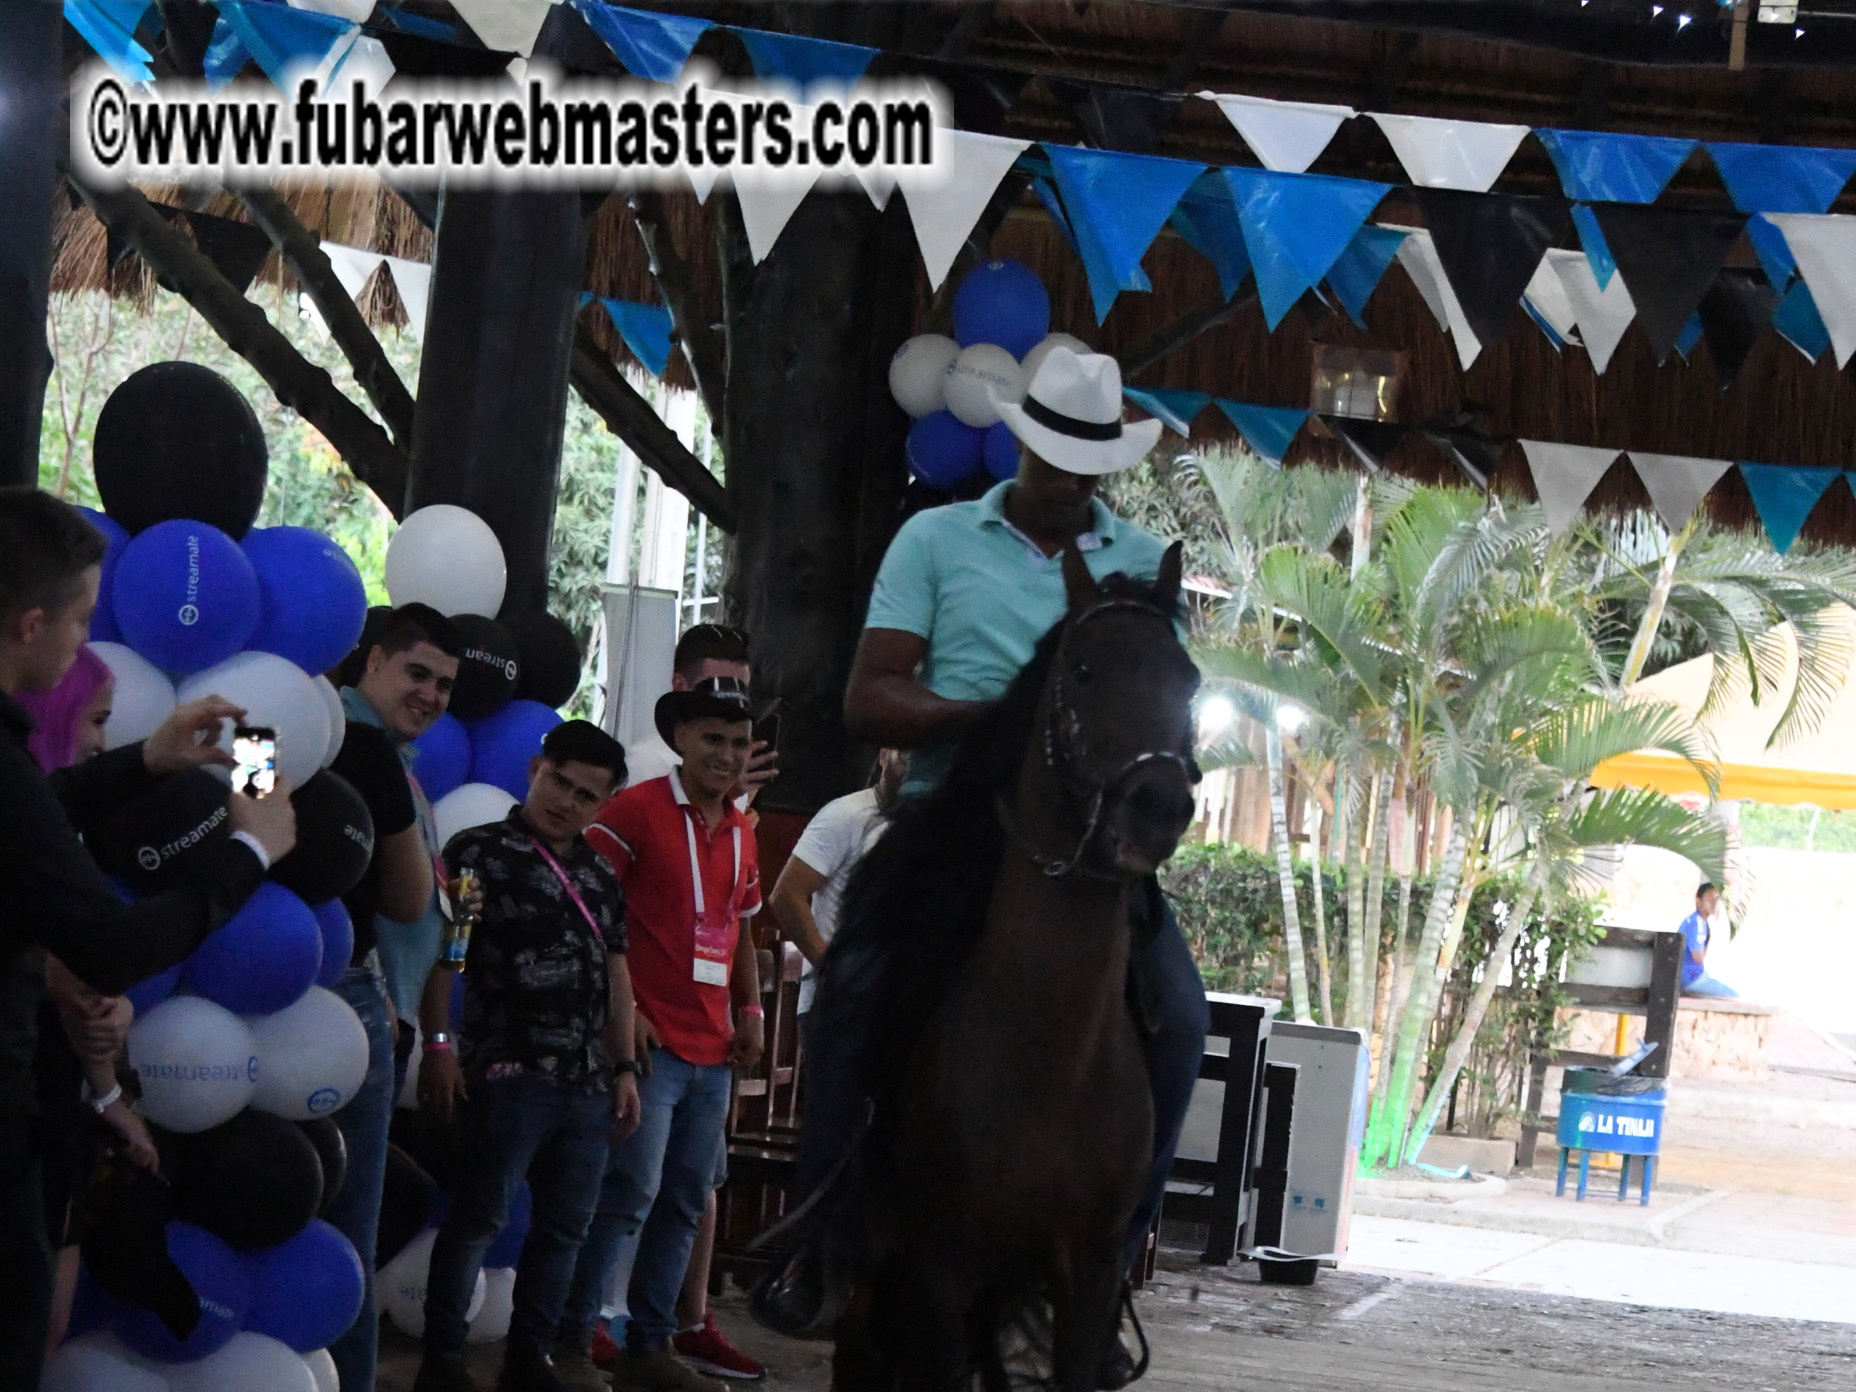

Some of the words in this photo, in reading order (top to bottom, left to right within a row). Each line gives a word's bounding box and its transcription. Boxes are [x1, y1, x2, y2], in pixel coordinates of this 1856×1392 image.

[187, 535, 199, 603] streamate
[465, 648, 506, 669] stream
[160, 806, 228, 861] streamate
[1597, 1114, 1613, 1134] LA
